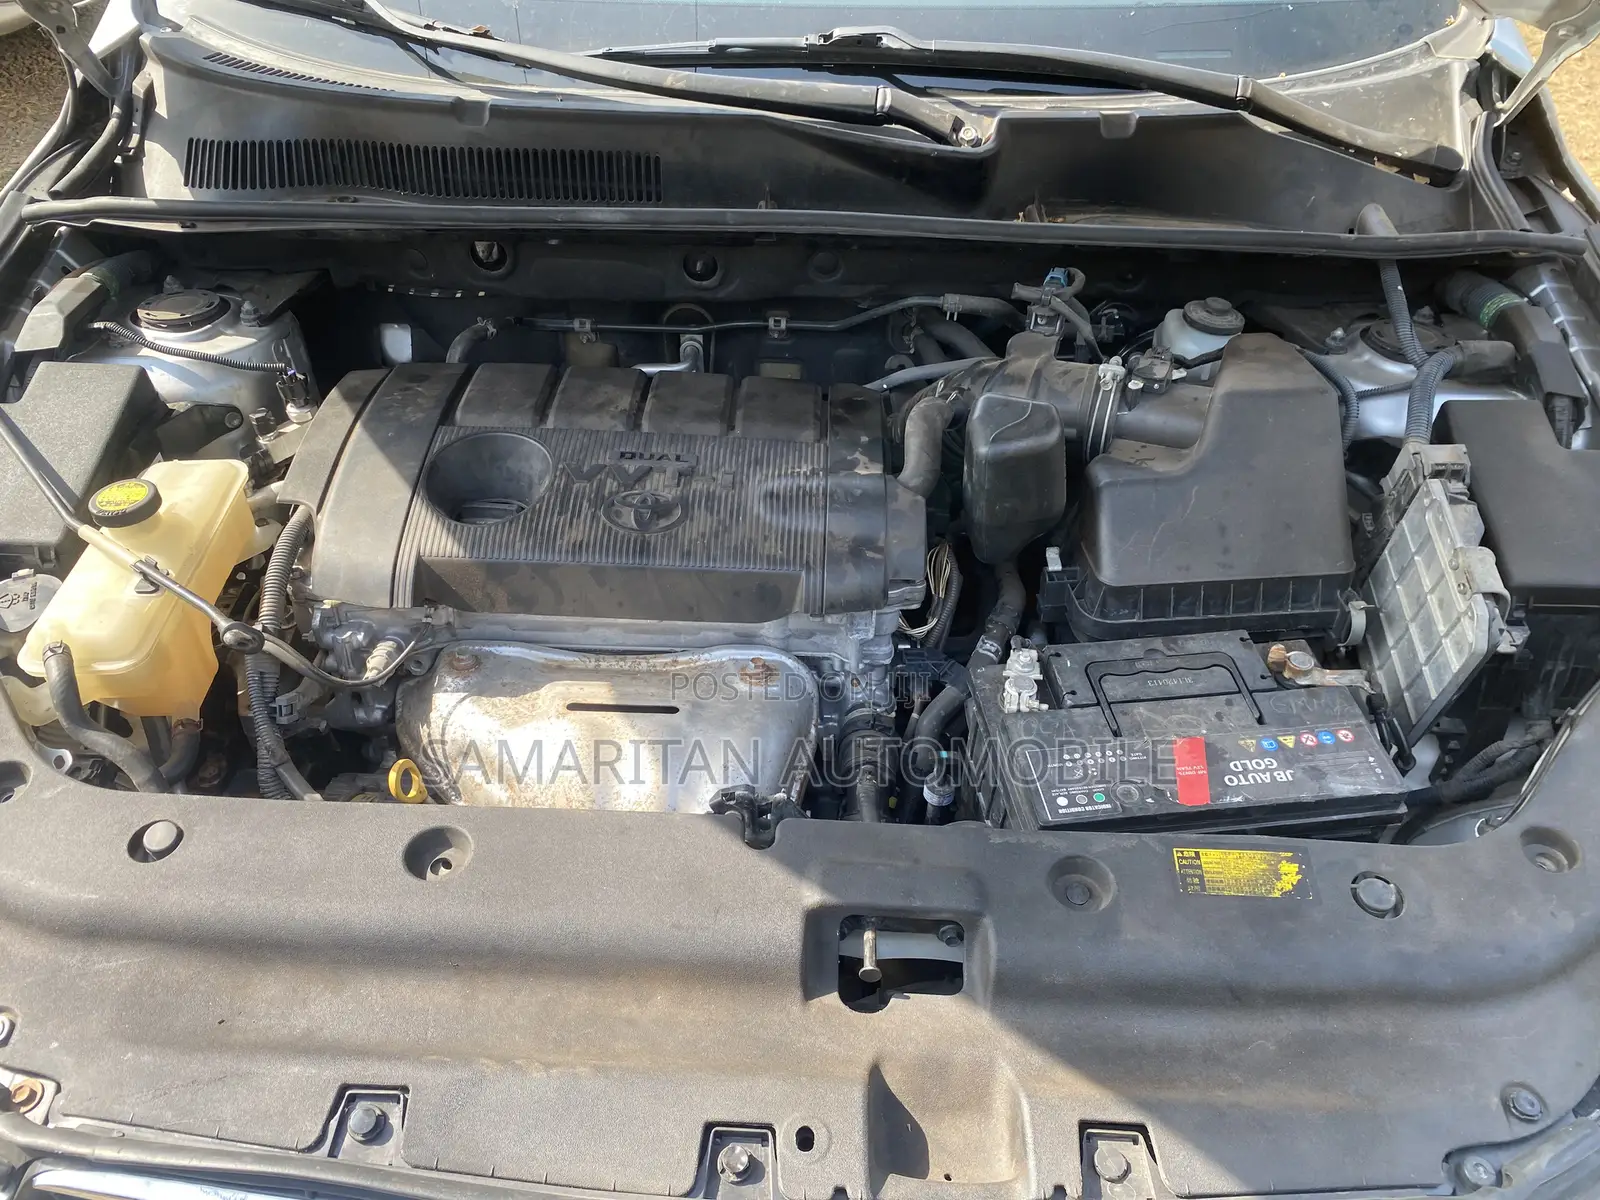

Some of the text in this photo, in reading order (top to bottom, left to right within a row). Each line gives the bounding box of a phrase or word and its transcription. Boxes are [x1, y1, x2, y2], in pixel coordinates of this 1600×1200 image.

[619, 451, 689, 464] DUAL
[1229, 757, 1278, 772] GOLD
[1223, 768, 1295, 786] JB AUTO
[1057, 803, 1112, 814] INDICATOR CONDITION
[1178, 858, 1201, 866] CAUTION
